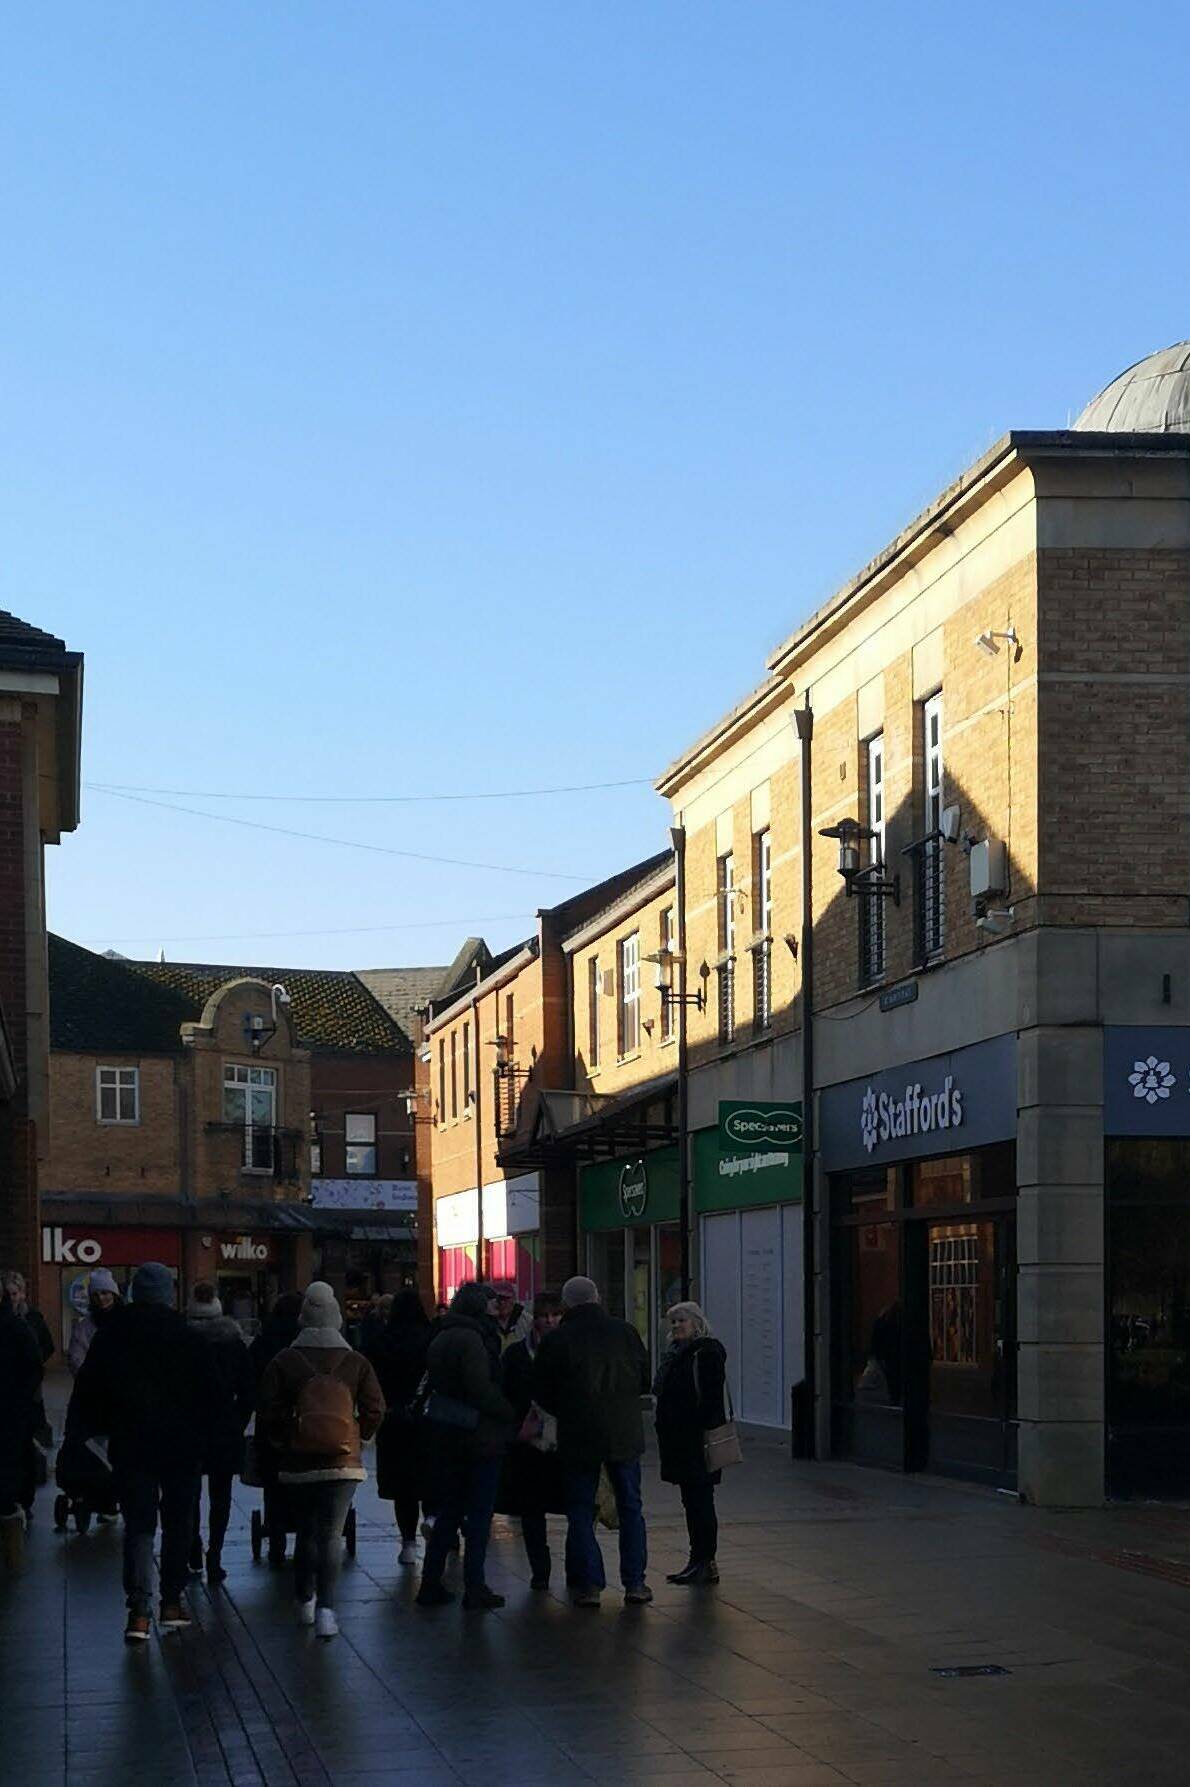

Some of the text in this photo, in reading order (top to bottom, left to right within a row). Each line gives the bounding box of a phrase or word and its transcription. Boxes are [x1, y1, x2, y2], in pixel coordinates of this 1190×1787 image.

[879, 1075, 962, 1141] Stafford's
[42, 1226, 102, 1264] lko
[220, 1234, 269, 1260] wilko
